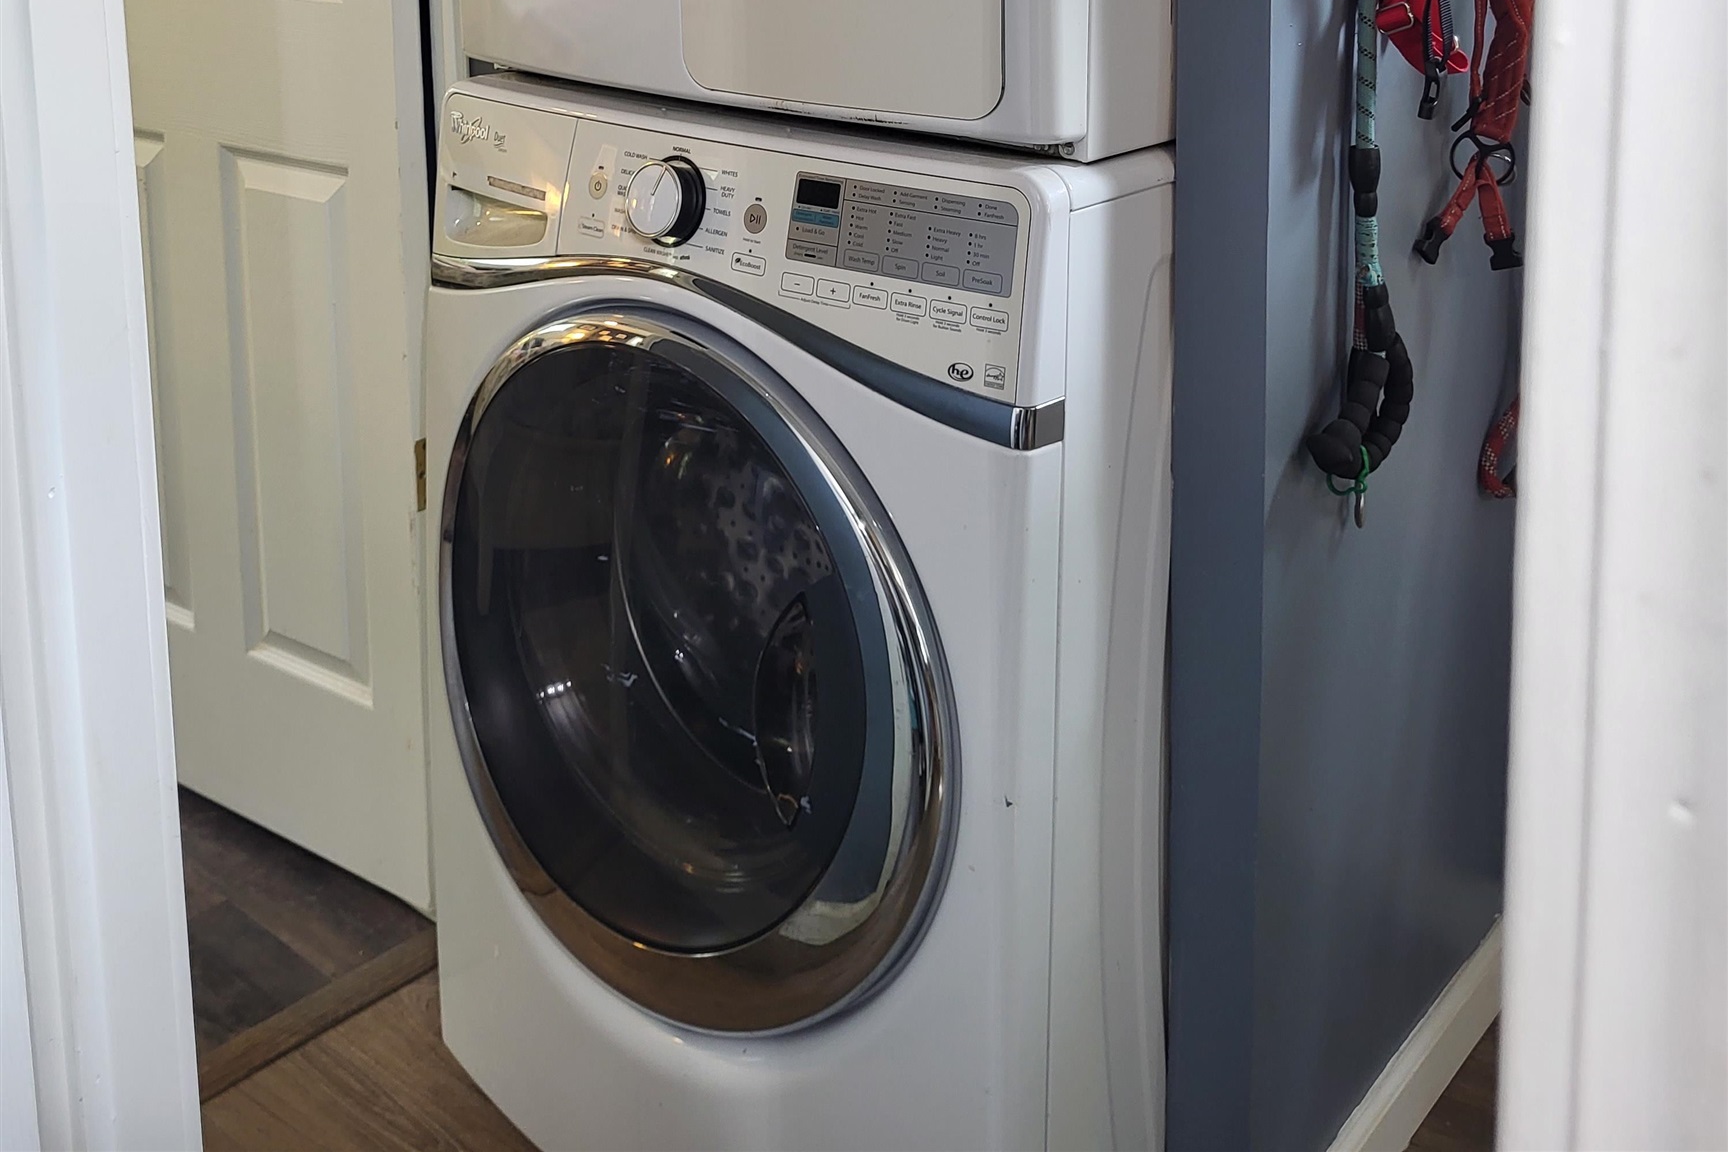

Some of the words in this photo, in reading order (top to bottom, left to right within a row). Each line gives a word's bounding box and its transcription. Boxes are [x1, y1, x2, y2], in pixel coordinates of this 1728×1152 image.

[450, 110, 490, 145] Whirlpool
[672, 145, 691, 155] NORMAL
[636, 152, 648, 160] WASH
[721, 169, 738, 178] WHITES
[941, 198, 966, 207] Dispensing
[713, 207, 731, 217] TOWELS
[894, 212, 906, 220] Extra
[984, 212, 1005, 220] FanFresh
[705, 227, 728, 237] ALLERGEN
[933, 226, 946, 234] Extra
[946, 230, 961, 238] Heavy
[932, 236, 948, 244] Heavy
[643, 246, 656, 254] CLEAN
[705, 246, 725, 255] SANITIZE
[792, 243, 816, 252] Detergent
[815, 247, 829, 255] Level
[931, 245, 950, 253] Normal
[740, 261, 761, 270] EcoBoost
[860, 258, 875, 266] Temp
[971, 276, 993, 286] PreSoak
[859, 292, 881, 302] FanFresh
[894, 299, 907, 307] Extra
[908, 301, 922, 310] Rinse
[932, 305, 947, 314] Cycle
[947, 308, 964, 317] Signal
[972, 313, 992, 322] Control
[993, 316, 1006, 325] Lock
[950, 363, 970, 380] he
